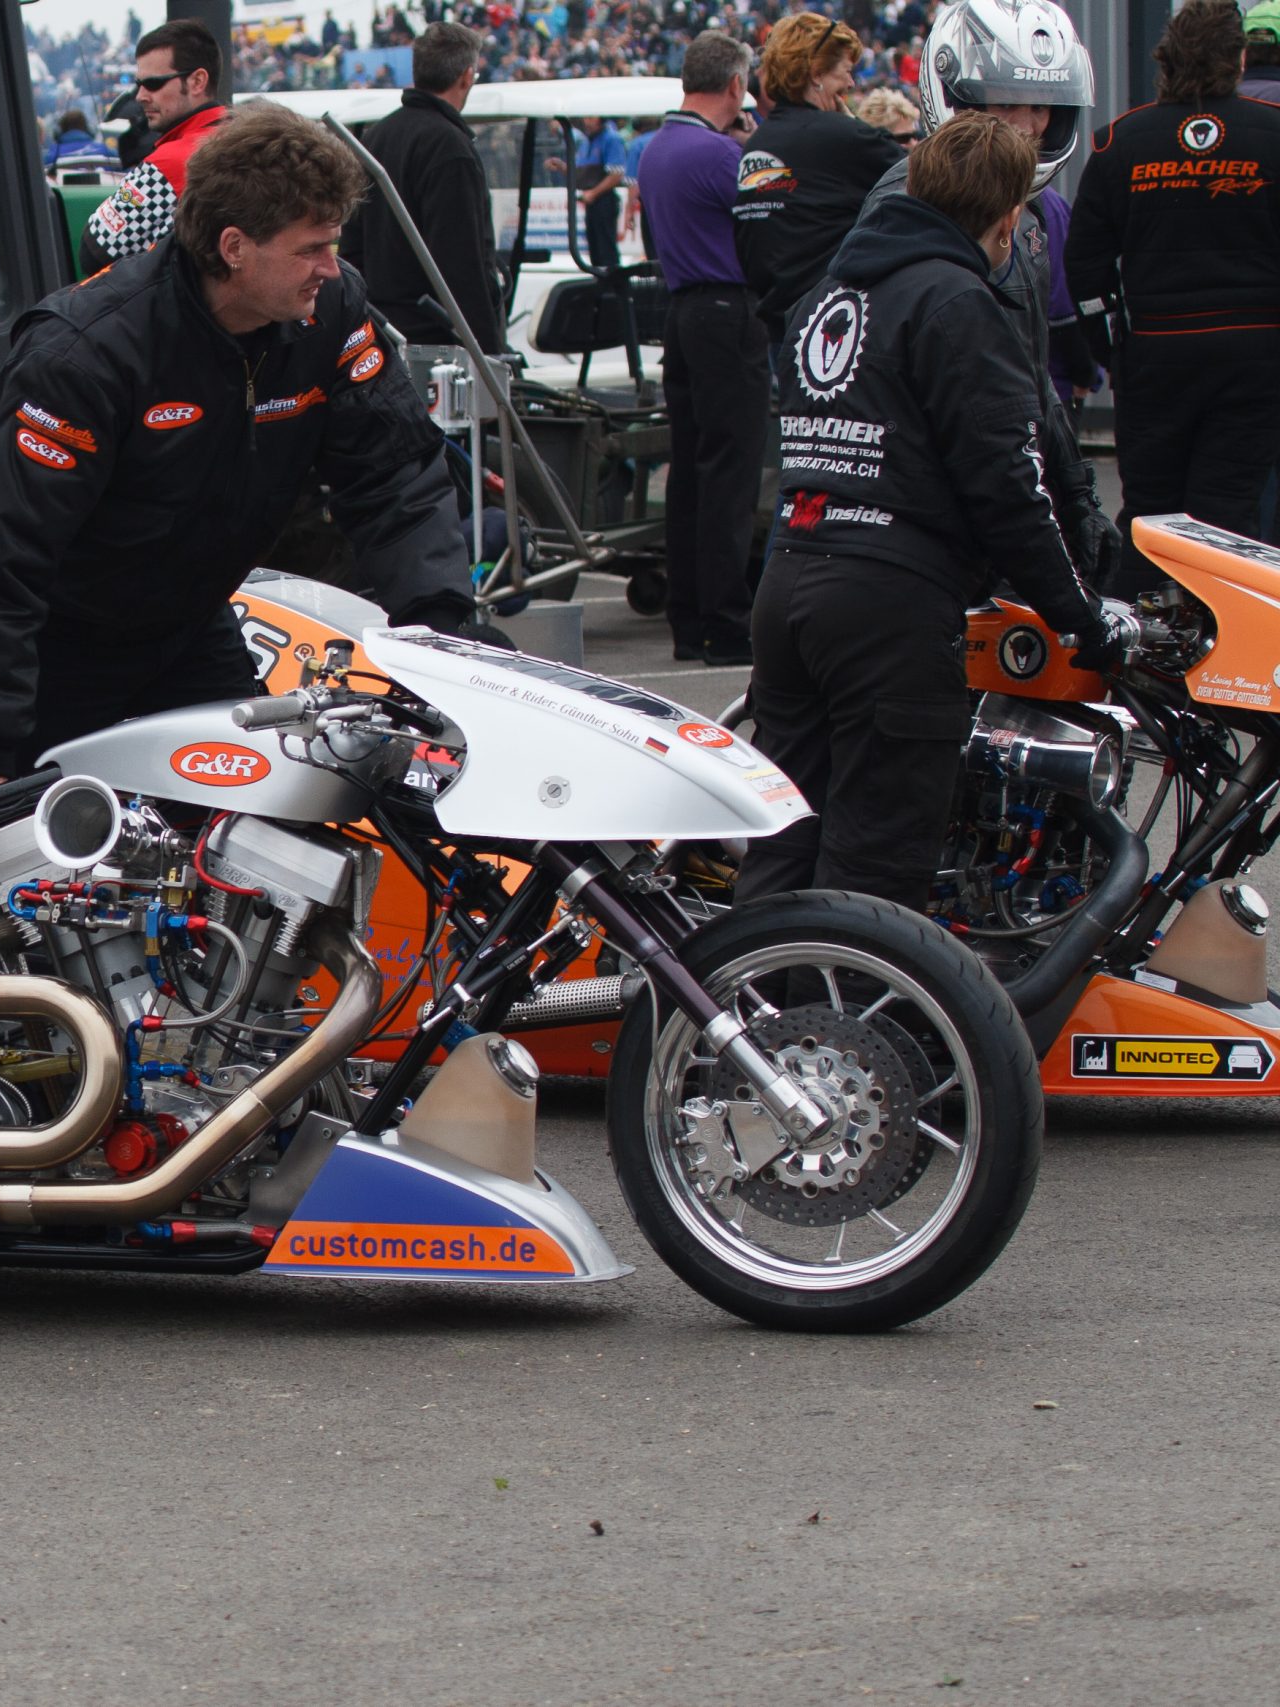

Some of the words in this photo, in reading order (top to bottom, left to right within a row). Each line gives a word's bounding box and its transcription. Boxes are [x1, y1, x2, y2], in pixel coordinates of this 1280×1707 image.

[1012, 66, 1071, 82] SHARK
[1131, 160, 1259, 180] ERBACHER
[1131, 181, 1158, 193] TOP
[1162, 179, 1200, 189] FUEL
[148, 407, 195, 424] G&R
[780, 416, 885, 445] ERBACHER
[20, 433, 70, 465] G&R
[819, 444, 837, 454] DRAG
[837, 446, 857, 456] RACE
[857, 448, 884, 459] TEAM
[824, 505, 894, 526] inside
[1234, 676, 1261, 692] Memory
[469, 673, 509, 694] Owner
[509, 687, 517, 697] &
[520, 689, 558, 709] Rider:
[559, 702, 609, 730] Günther
[608, 723, 640, 744] Sohn
[685, 727, 726, 744] G&R
[180, 751, 259, 777] G&R
[1120, 1050, 1214, 1065] INNOTEC
[289, 1232, 537, 1264] customcash.de
